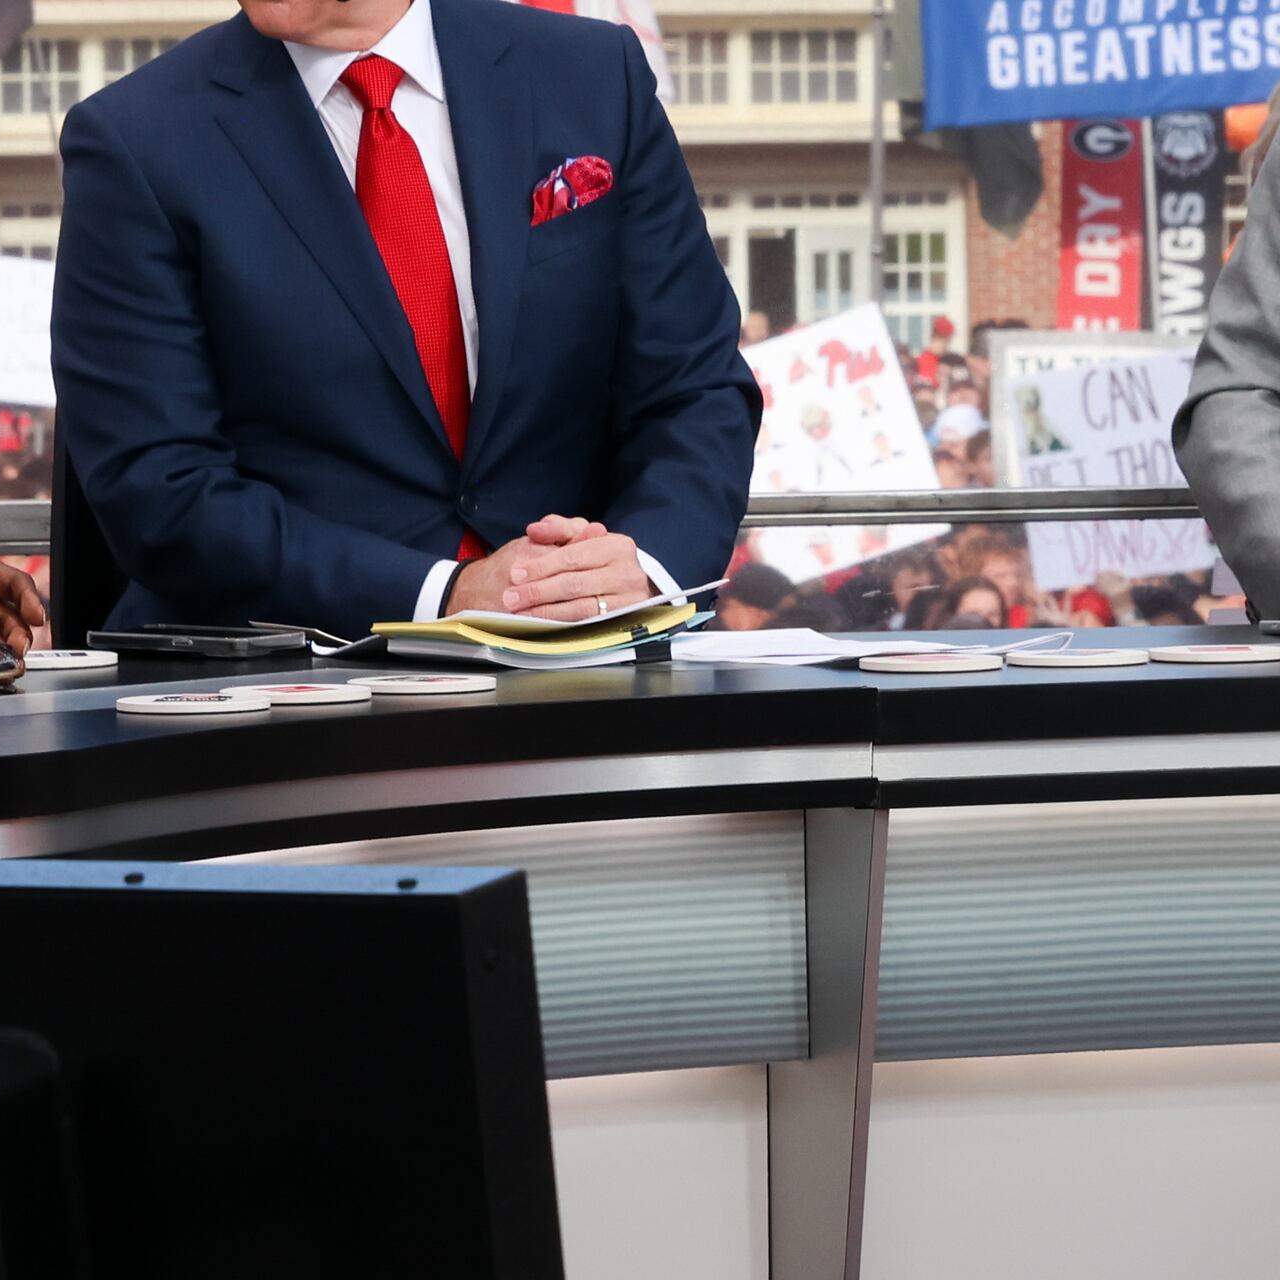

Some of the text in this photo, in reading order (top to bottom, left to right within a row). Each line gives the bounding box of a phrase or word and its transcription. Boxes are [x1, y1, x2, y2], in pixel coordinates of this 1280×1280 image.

[1074, 182, 1123, 298] DRY
[1159, 191, 1207, 336] AWGS
[1082, 365, 1160, 431] CAN
